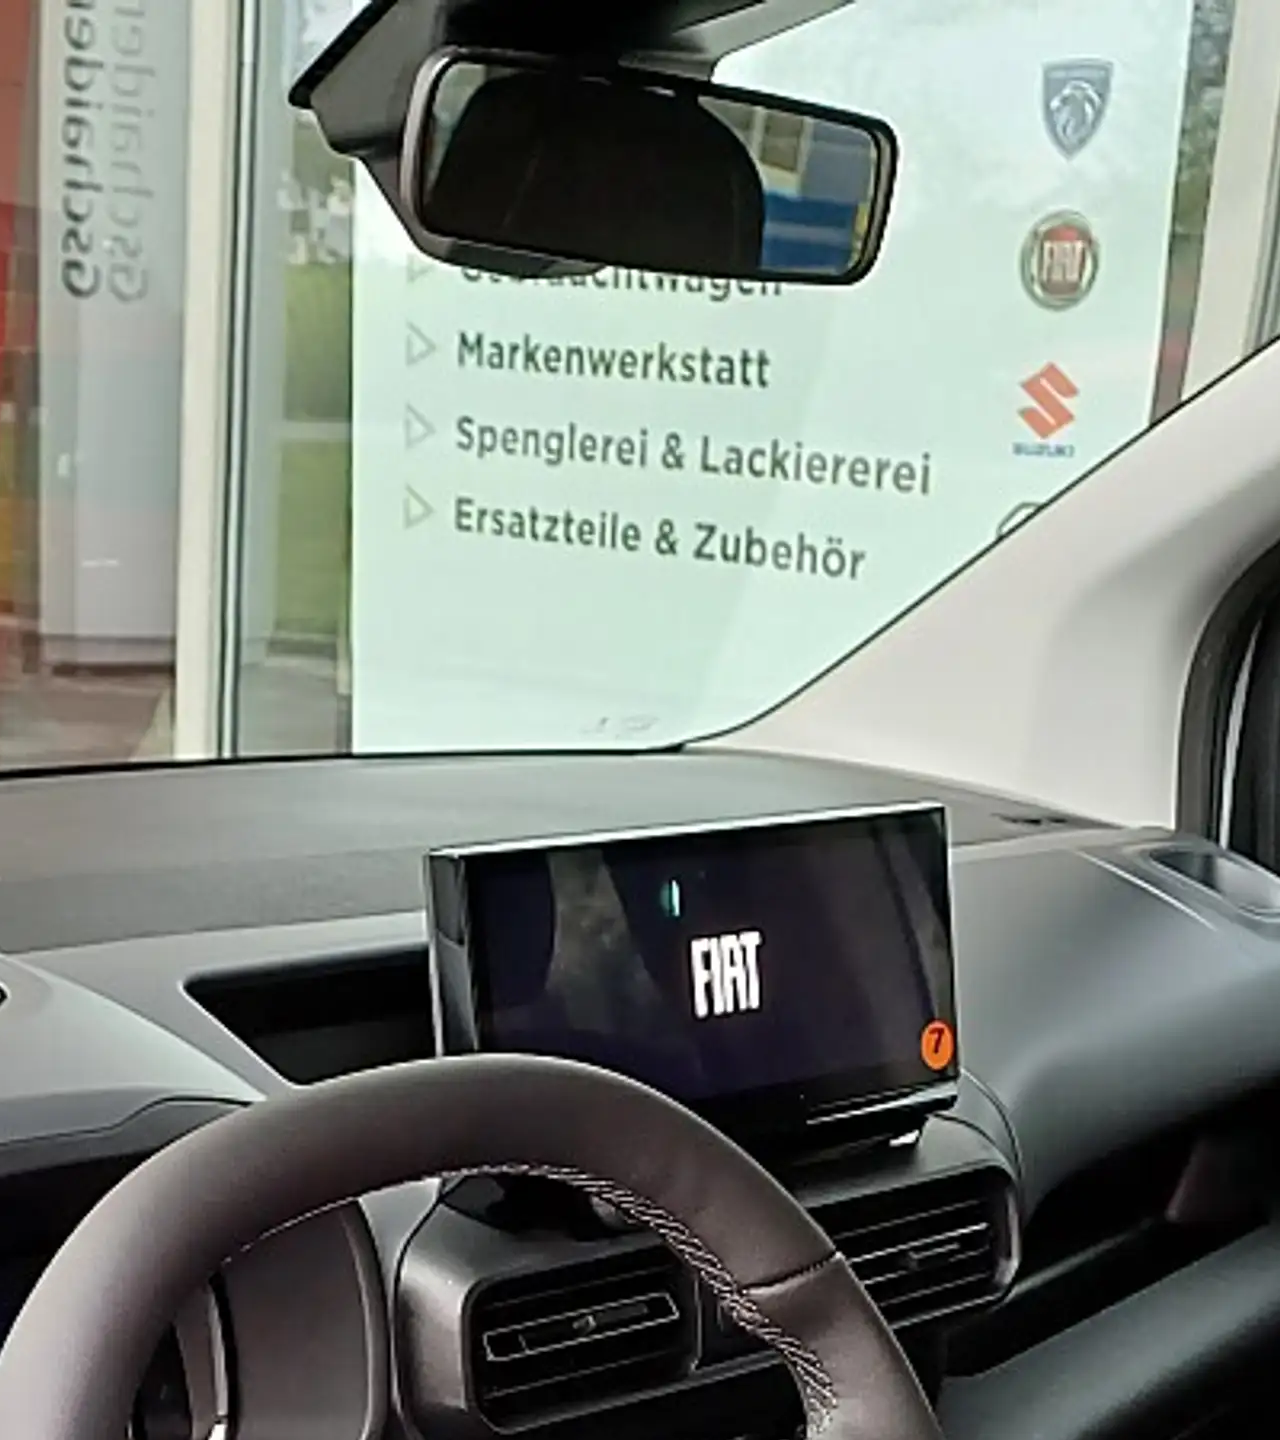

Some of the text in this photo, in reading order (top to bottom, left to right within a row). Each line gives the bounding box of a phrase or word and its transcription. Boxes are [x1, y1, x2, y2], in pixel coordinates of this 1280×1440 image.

[457, 331, 770, 388] Markenwerkstatt
[456, 415, 931, 496] Spenglerei & Lackiererei
[454, 497, 867, 581] Ersatzteile & Zubehör
[690, 931, 762, 1019] FIAT
[928, 1027, 945, 1055] 7
